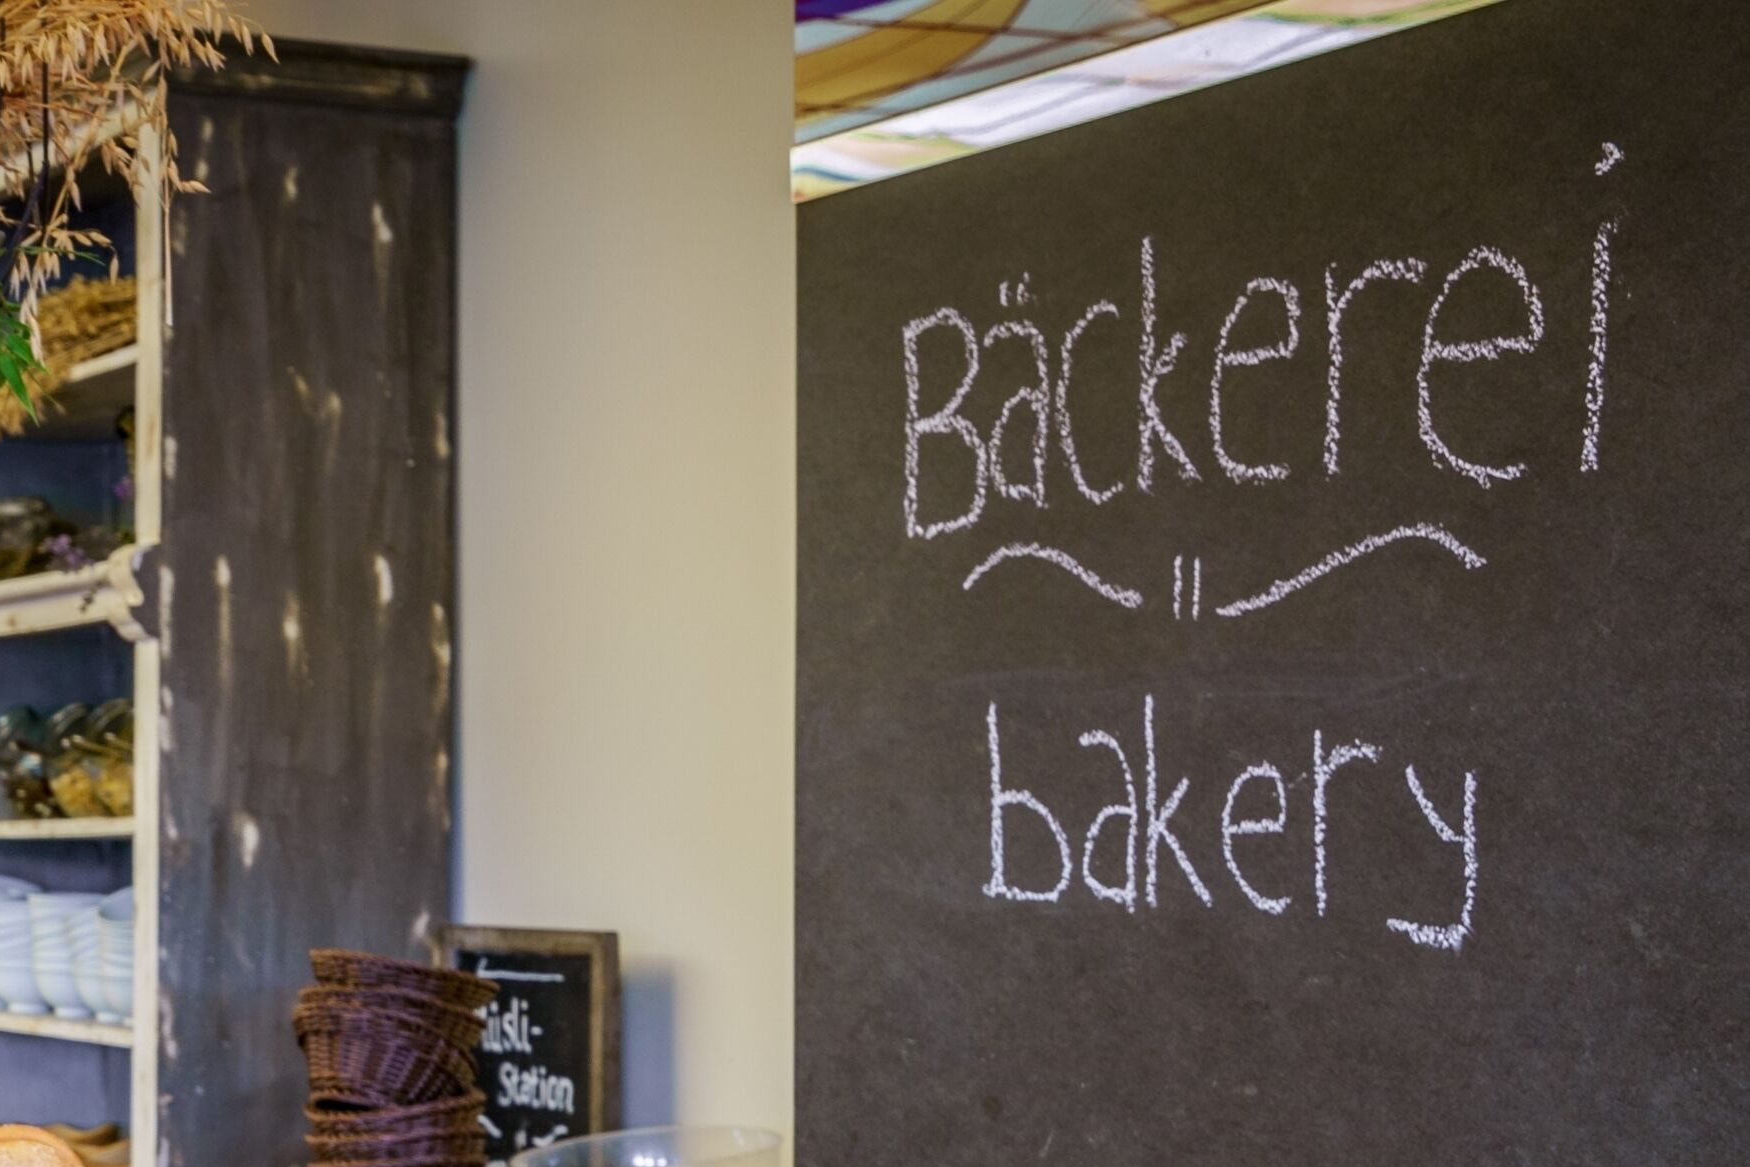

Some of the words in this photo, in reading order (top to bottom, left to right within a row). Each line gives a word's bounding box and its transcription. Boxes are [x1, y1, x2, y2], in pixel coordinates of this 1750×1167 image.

[903, 141, 1626, 538] Bäckerei
[981, 693, 1478, 952] bakery
[473, 996, 543, 1054] üsli-
[497, 1061, 575, 1115] Station
